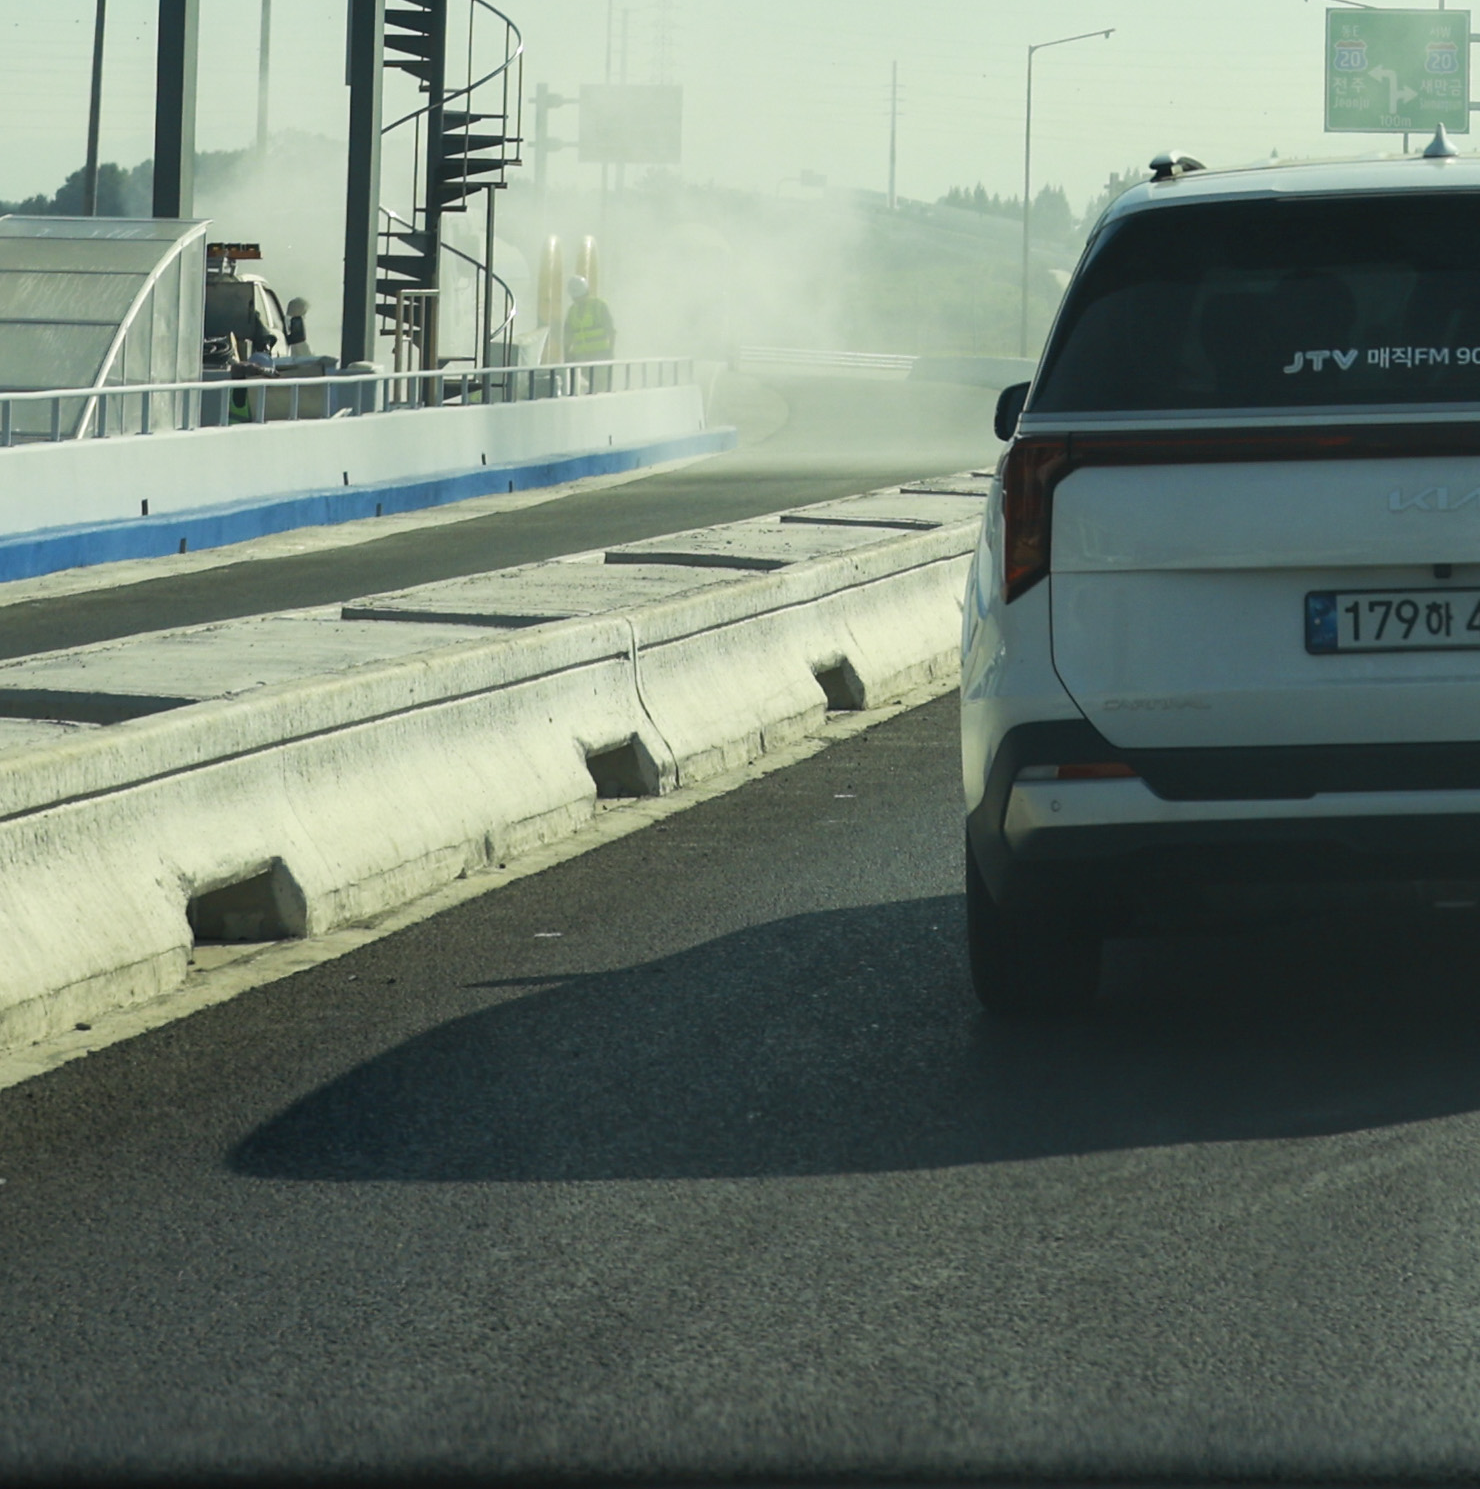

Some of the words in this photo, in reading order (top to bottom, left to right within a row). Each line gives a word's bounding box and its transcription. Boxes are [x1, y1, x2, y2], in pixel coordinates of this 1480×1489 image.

[1340, 52, 1361, 67] 20
[1431, 54, 1452, 69] 20
[1333, 77, 1366, 95] 전주
[1421, 79, 1463, 96] 새만금
[1380, 115, 1412, 127] 100m
[1283, 348, 1358, 374] JTV
[1367, 347, 1450, 368] 매직FM
[1344, 599, 1453, 642] 179하
